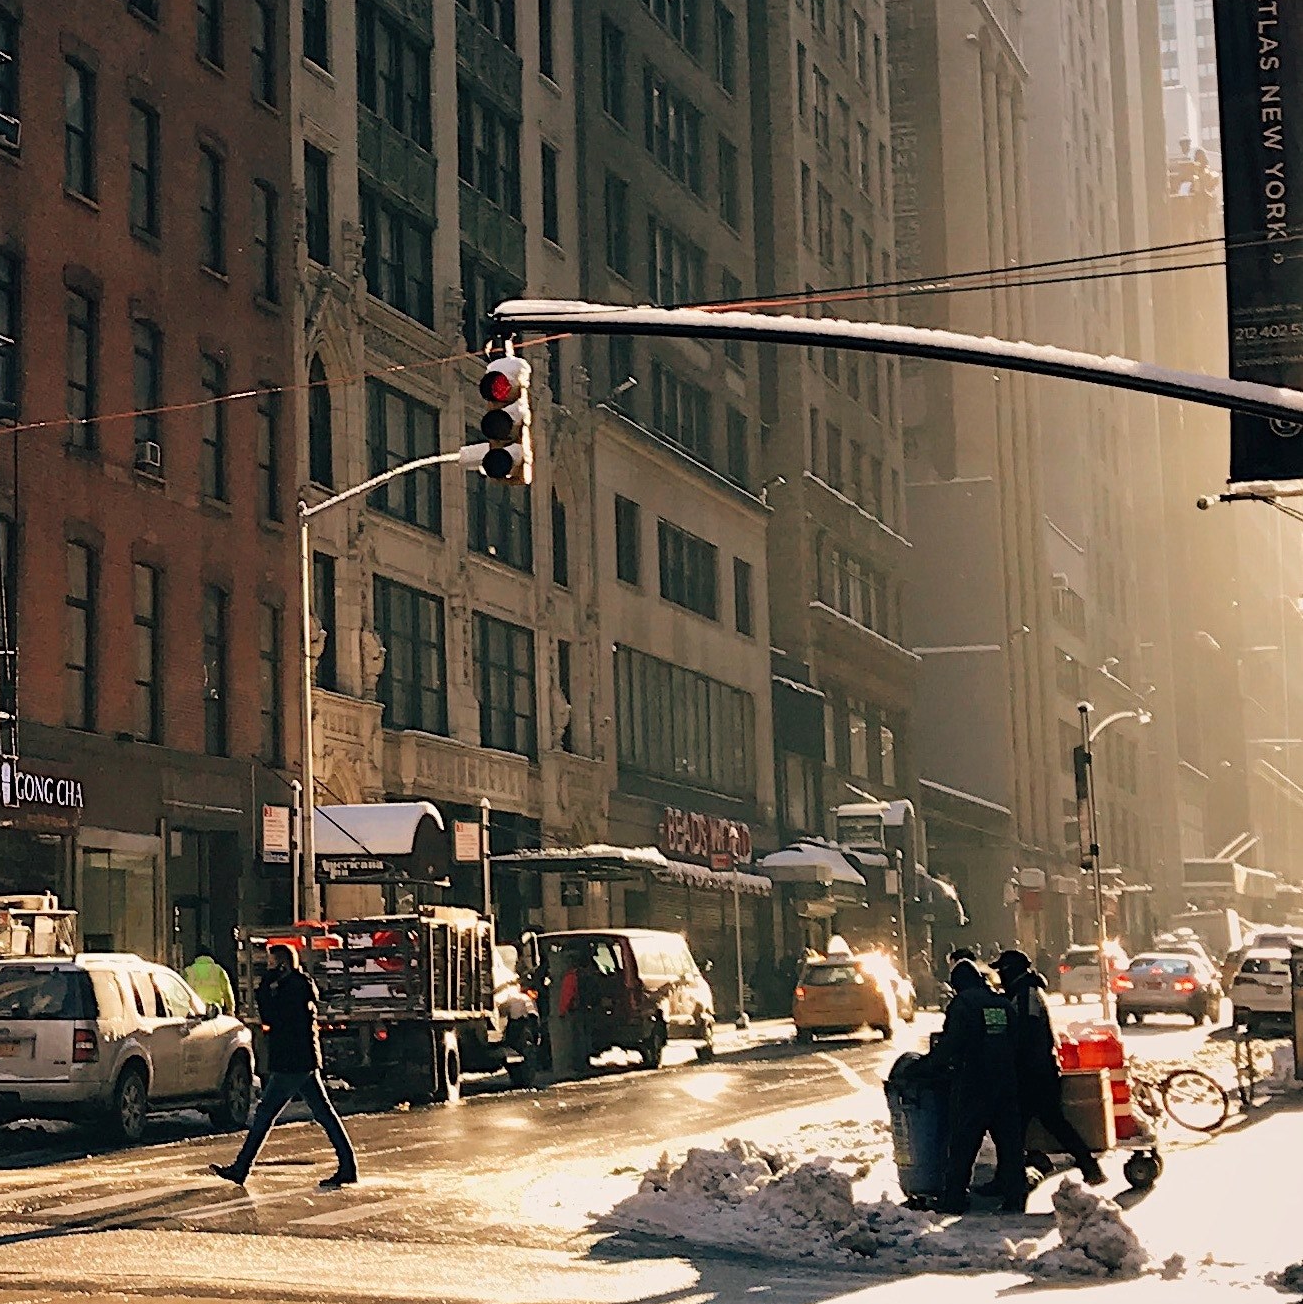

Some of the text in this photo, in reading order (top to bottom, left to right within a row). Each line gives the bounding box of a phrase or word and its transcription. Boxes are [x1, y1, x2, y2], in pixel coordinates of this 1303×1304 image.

[1260, 84, 1284, 151] NEW
[1264, 163, 1289, 241] YORK
[16, 771, 84, 808] GONG CHA
